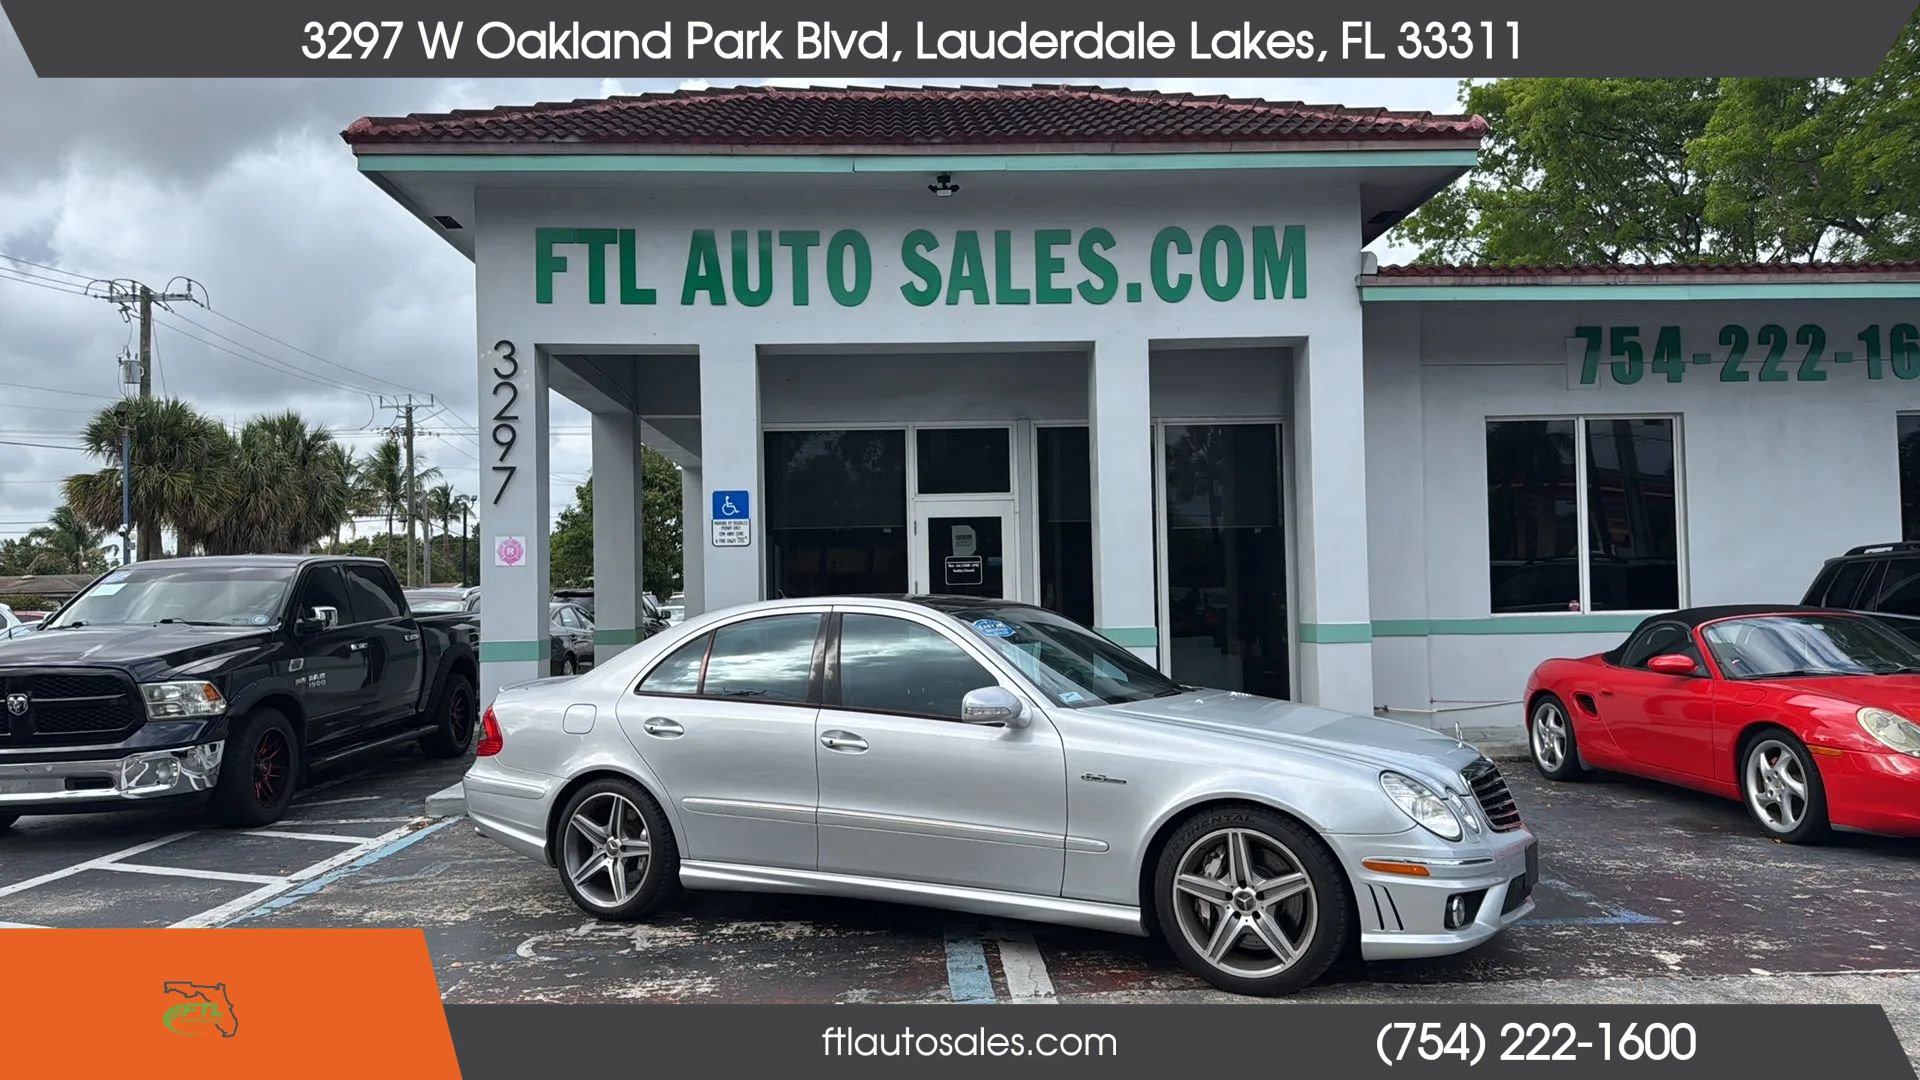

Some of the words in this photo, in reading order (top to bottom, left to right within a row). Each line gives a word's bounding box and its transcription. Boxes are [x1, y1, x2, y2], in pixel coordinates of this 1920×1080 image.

[535, 228, 657, 306] FTL
[680, 228, 872, 309] AUTO
[900, 224, 1309, 309] SALES.COM
[492, 339, 520, 506] 3297
[507, 547, 514, 555] R
[309, 679, 327, 688] 1500
